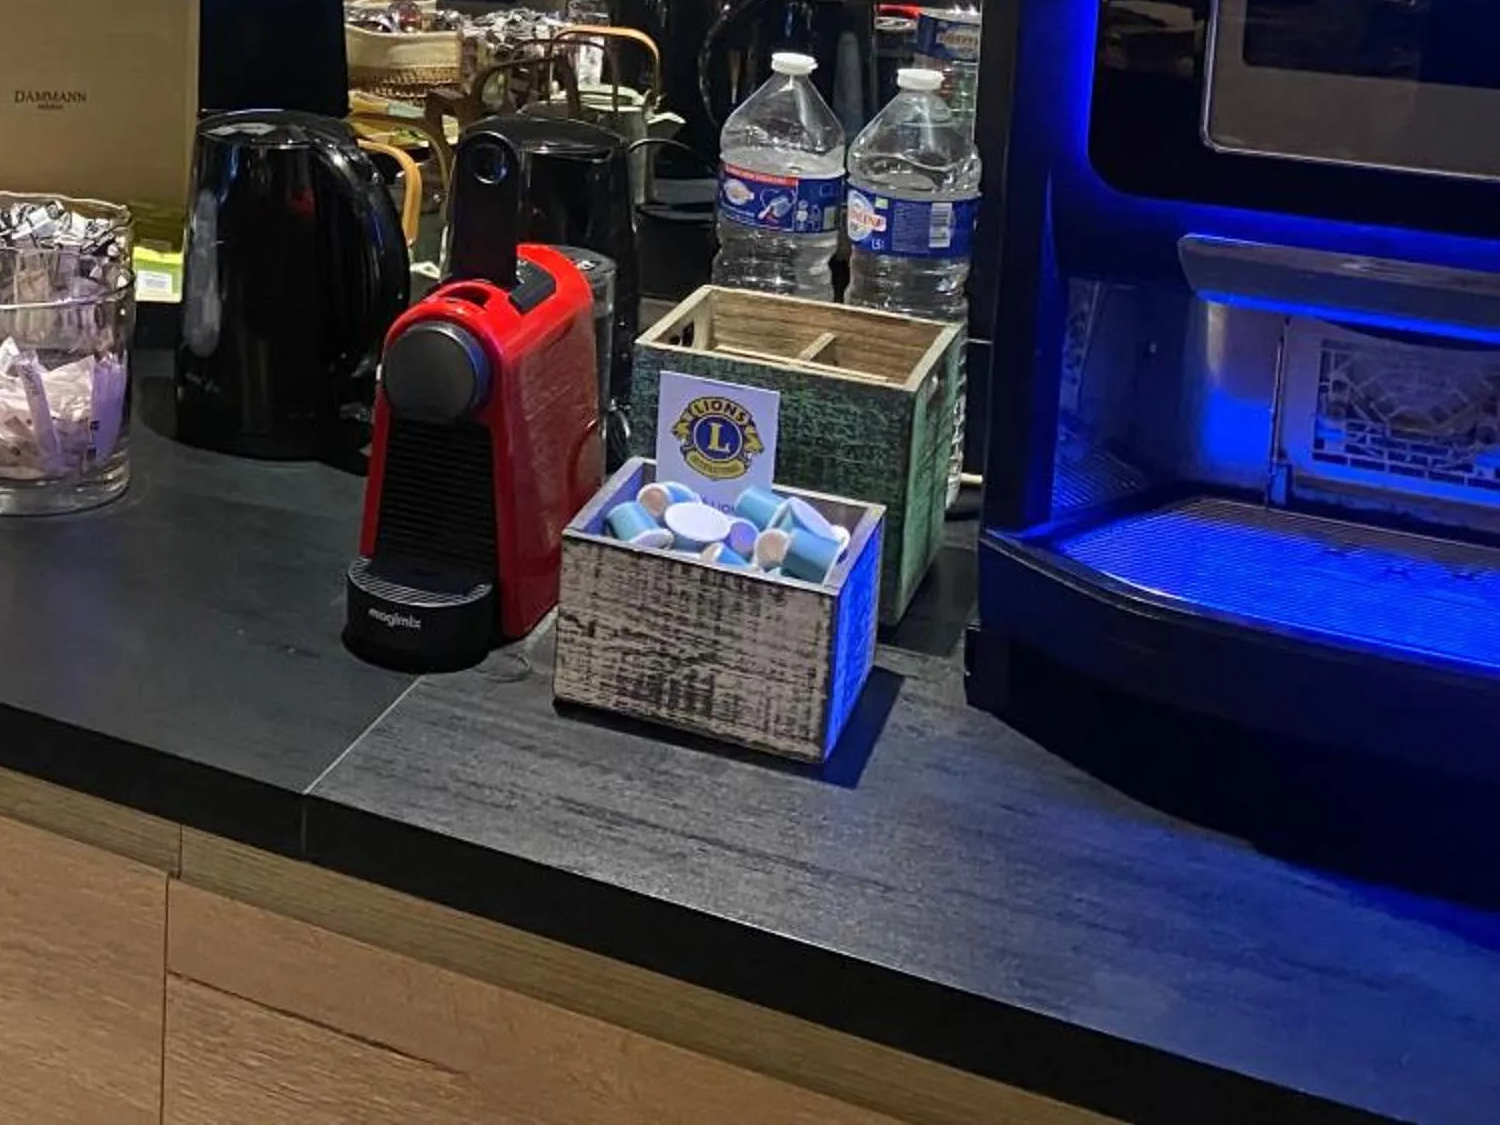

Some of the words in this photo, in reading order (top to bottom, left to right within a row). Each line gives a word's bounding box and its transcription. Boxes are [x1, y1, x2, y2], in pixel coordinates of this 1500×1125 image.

[14, 90, 87, 104] DAMMANN
[693, 399, 749, 423] LIONS
[707, 421, 731, 454] L
[368, 608, 421, 630] magimix
